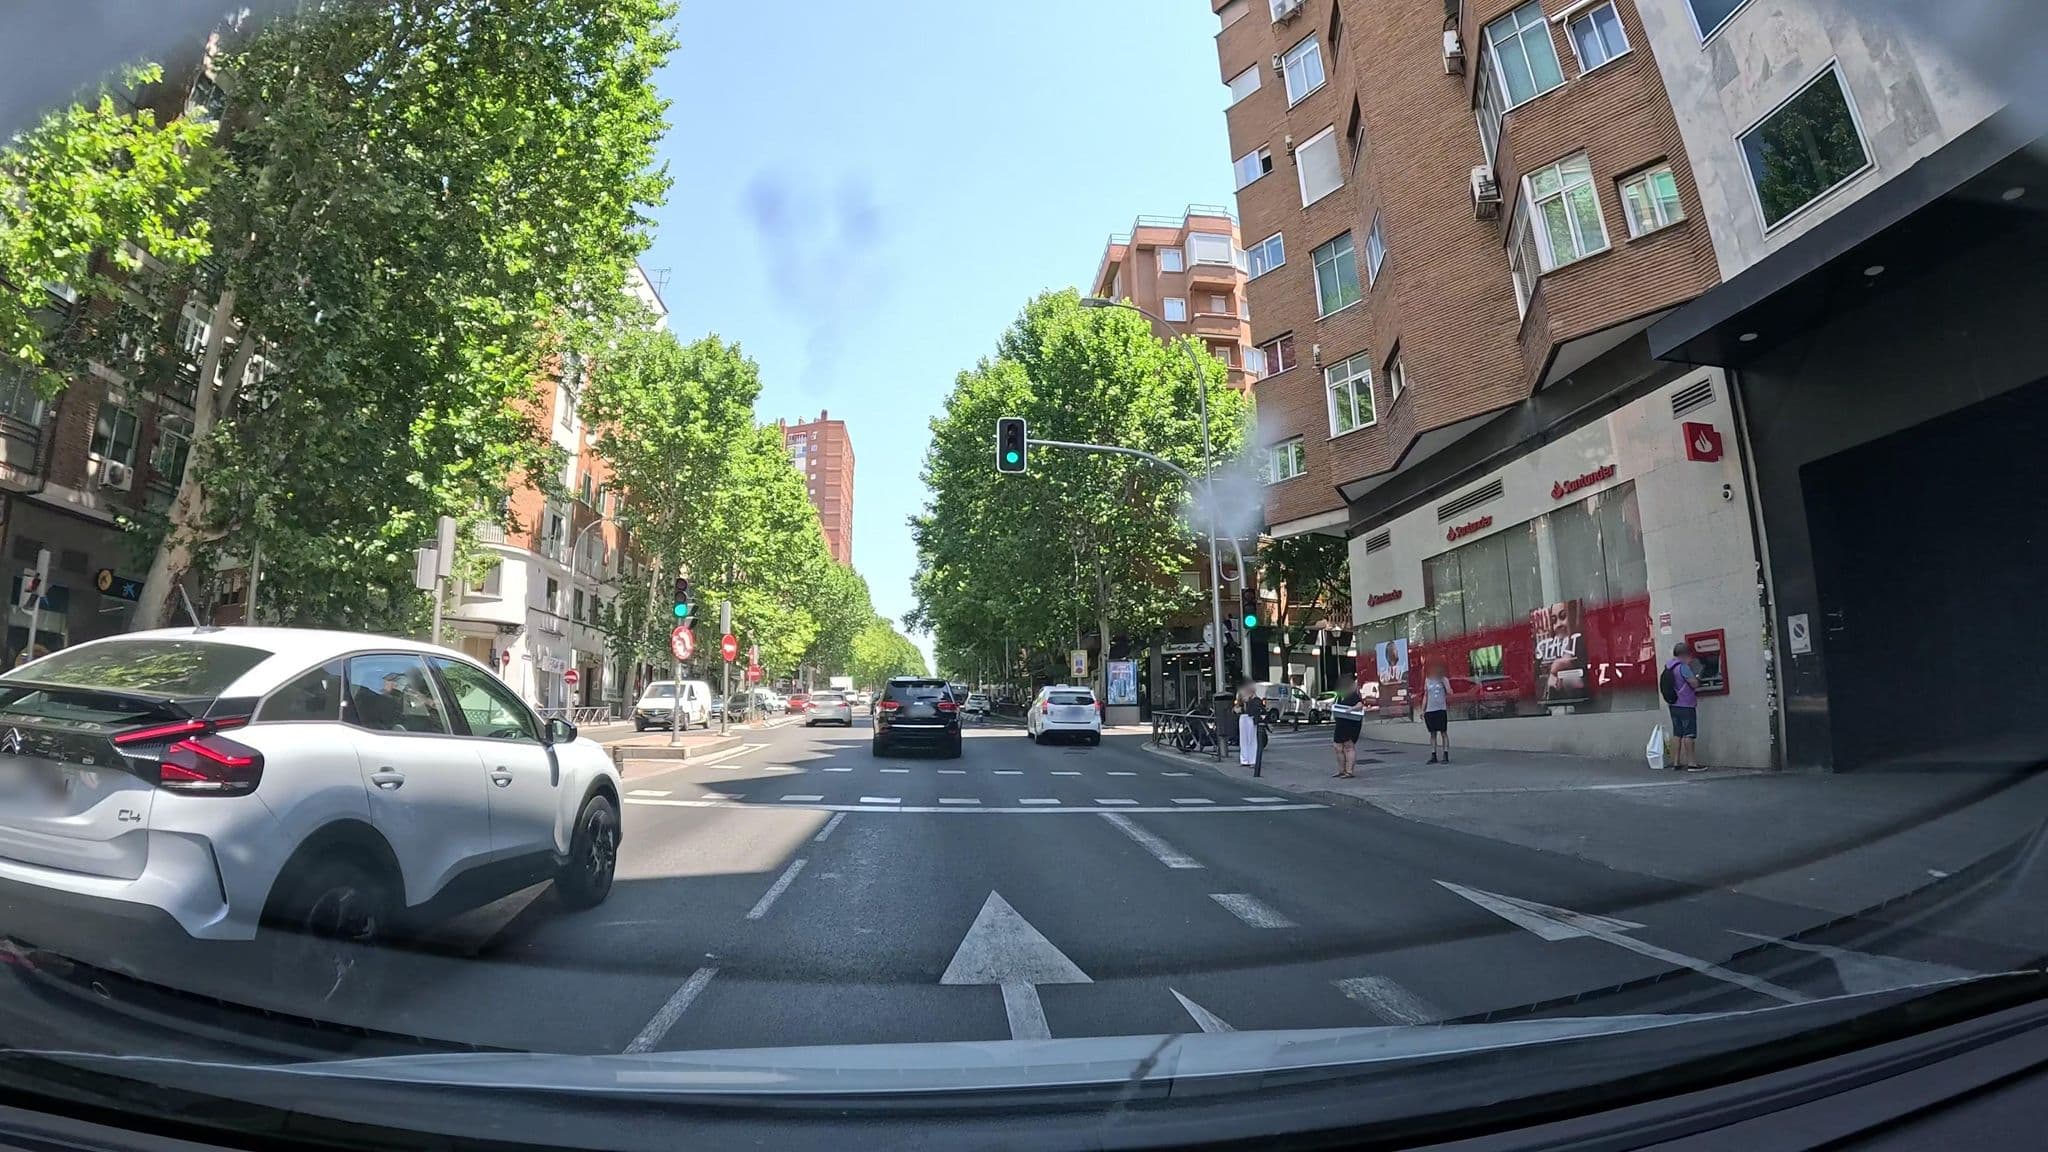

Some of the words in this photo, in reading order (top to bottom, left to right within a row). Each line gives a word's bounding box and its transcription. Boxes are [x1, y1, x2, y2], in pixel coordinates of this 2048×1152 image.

[1563, 464, 1616, 494] Santander
[1456, 516, 1492, 537] Santander
[1536, 633, 1581, 660] START
[118, 809, 141, 822] C4
